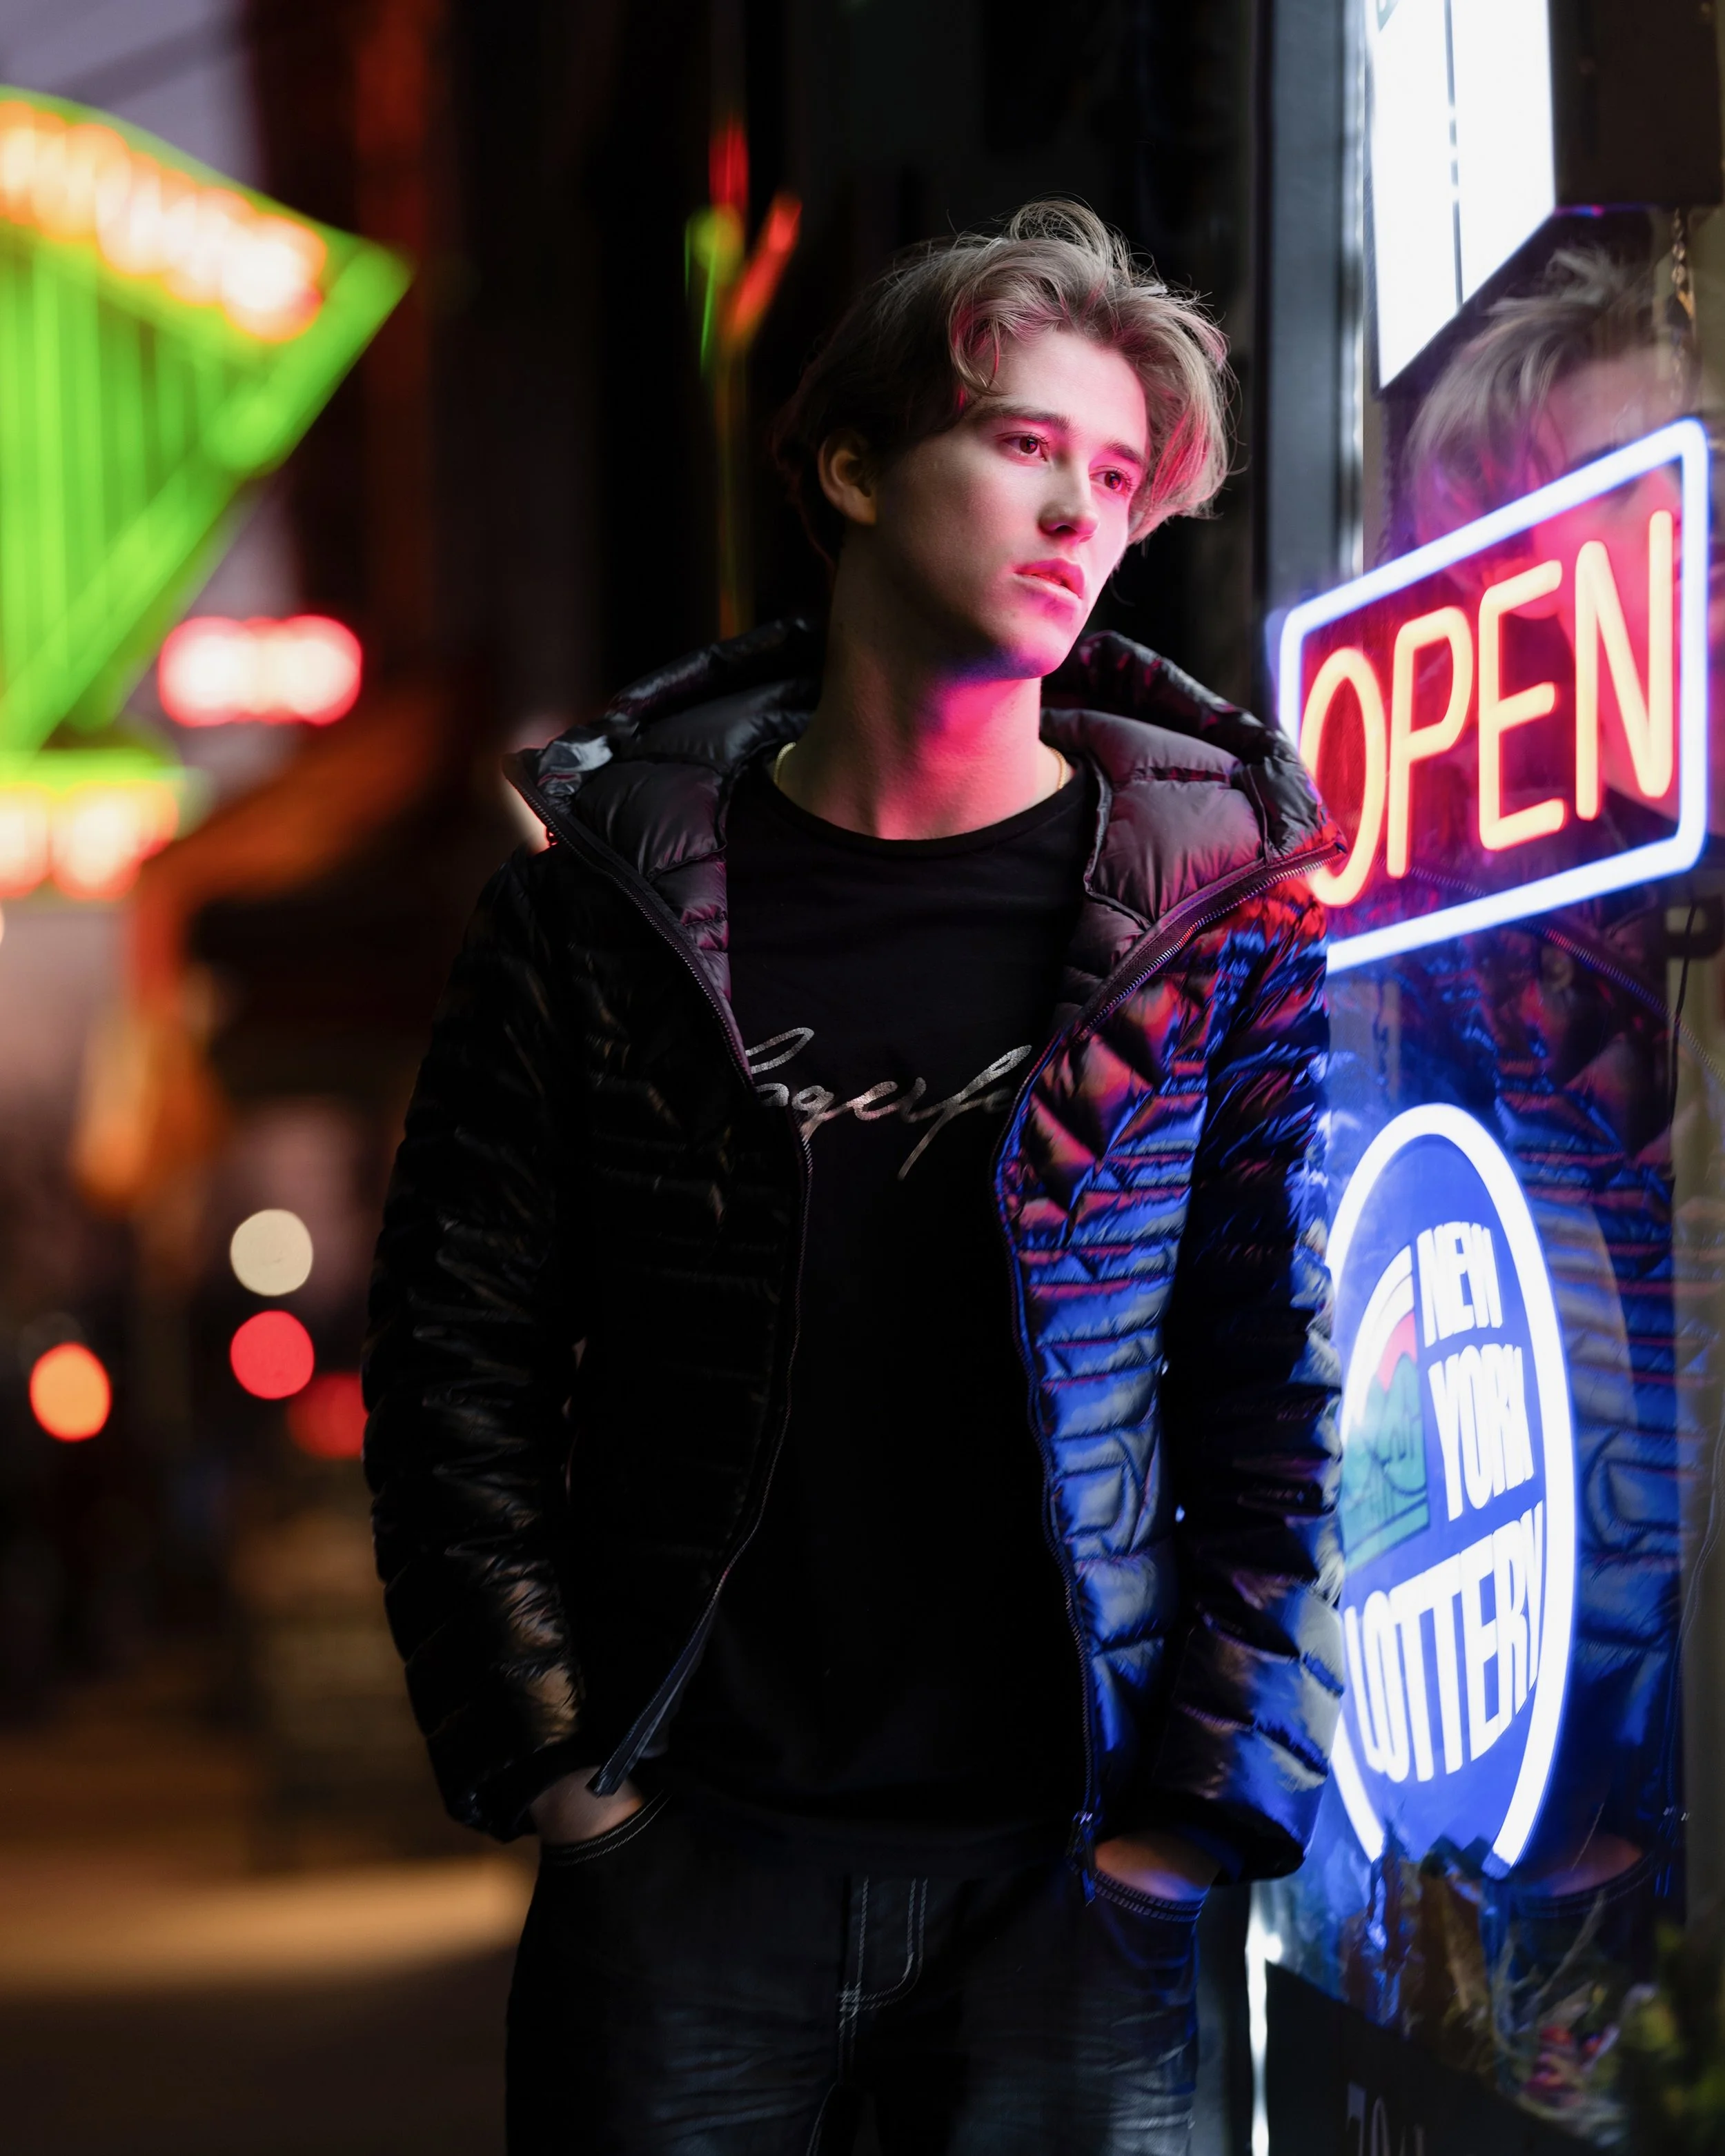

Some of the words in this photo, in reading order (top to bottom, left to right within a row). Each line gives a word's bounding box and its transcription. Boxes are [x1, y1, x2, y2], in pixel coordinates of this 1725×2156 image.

[1300, 509, 1674, 908] OPEN
[1417, 1221, 1503, 1347] NEW
[1428, 1343, 1534, 1522] YORK
[1344, 1500, 1543, 1783] LOTTERY
